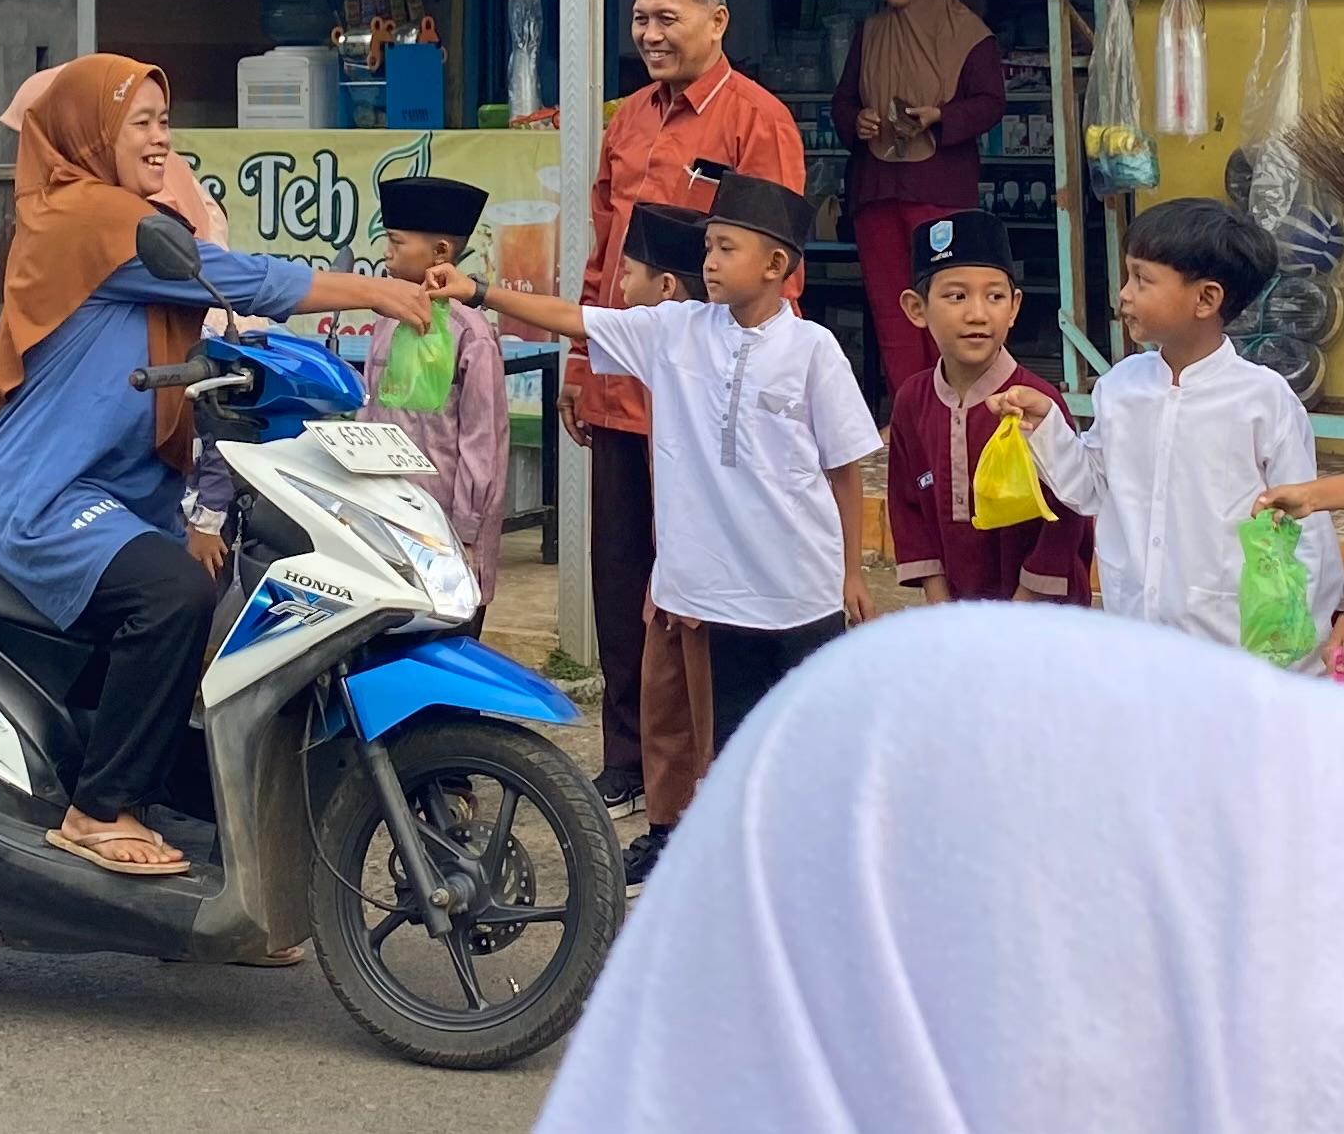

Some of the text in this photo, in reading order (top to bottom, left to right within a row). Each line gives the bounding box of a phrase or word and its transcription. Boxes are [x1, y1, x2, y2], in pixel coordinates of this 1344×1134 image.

[238, 148, 359, 250] Teh
[315, 426, 337, 446] G
[337, 426, 382, 446] 6539
[283, 569, 355, 602] HONDA
